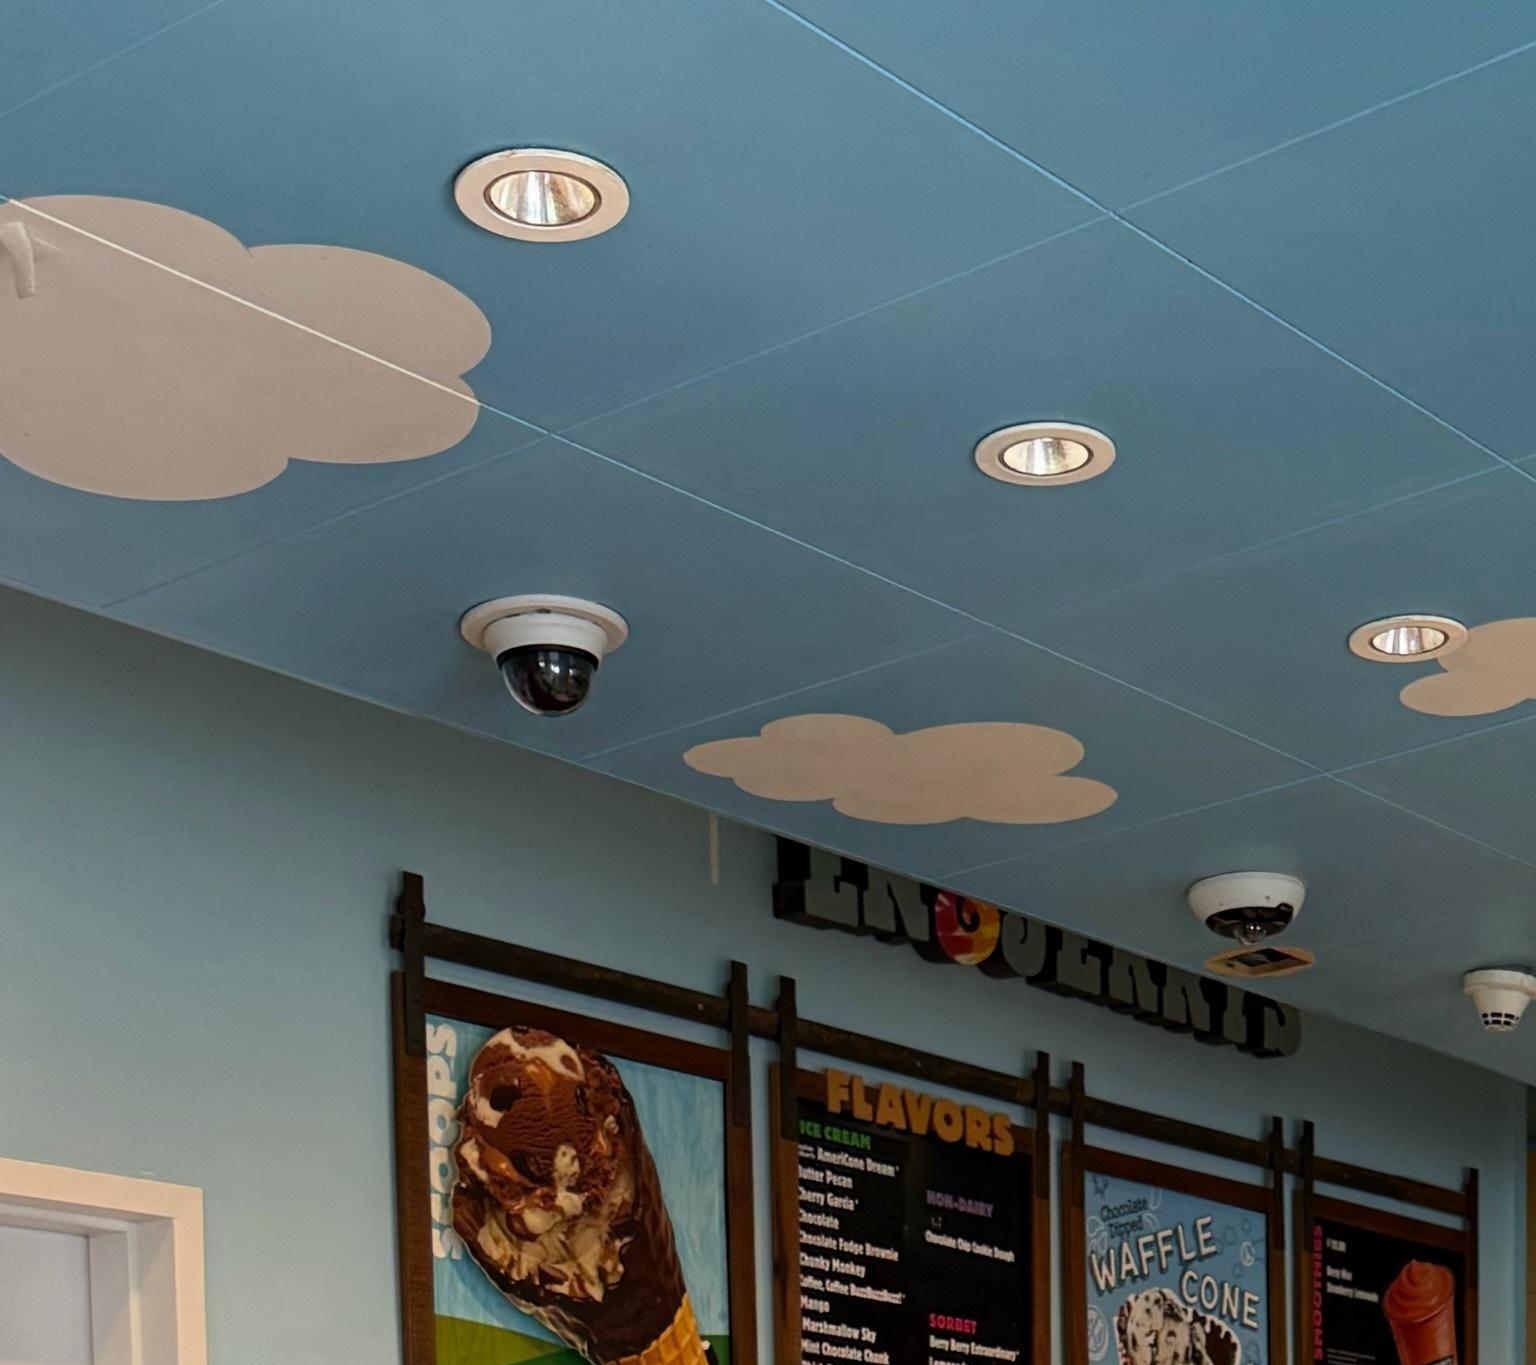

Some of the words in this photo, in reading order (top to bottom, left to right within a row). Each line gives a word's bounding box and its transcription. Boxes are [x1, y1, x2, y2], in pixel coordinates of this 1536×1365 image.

[826, 1069, 1014, 1156] FLAVORS
[800, 1120, 822, 1139] ICE
[824, 1126, 872, 1151] CREAM
[826, 1169, 854, 1189] Pecan
[826, 1192, 856, 1212] Garcia
[926, 1189, 994, 1219] NON-DAIRY
[799, 1230, 838, 1251] Chocolate
[838, 1237, 864, 1256] Fudge
[1091, 1216, 1217, 1290] WAFFLE
[800, 1251, 830, 1272] Chunky
[831, 1256, 867, 1279] Monkey
[825, 1278, 849, 1296] Coffee
[1182, 1270, 1259, 1328] CONE
[800, 1294, 831, 1315] Mango
[802, 1316, 860, 1340] Marshmallow
[860, 1325, 877, 1344] Sky
[929, 1312, 978, 1335] SORBET
[801, 1338, 820, 1356] Mint
[821, 1341, 863, 1362] Chocolate
[929, 1334, 949, 1351] Berry
[950, 1338, 970, 1355] Berry
